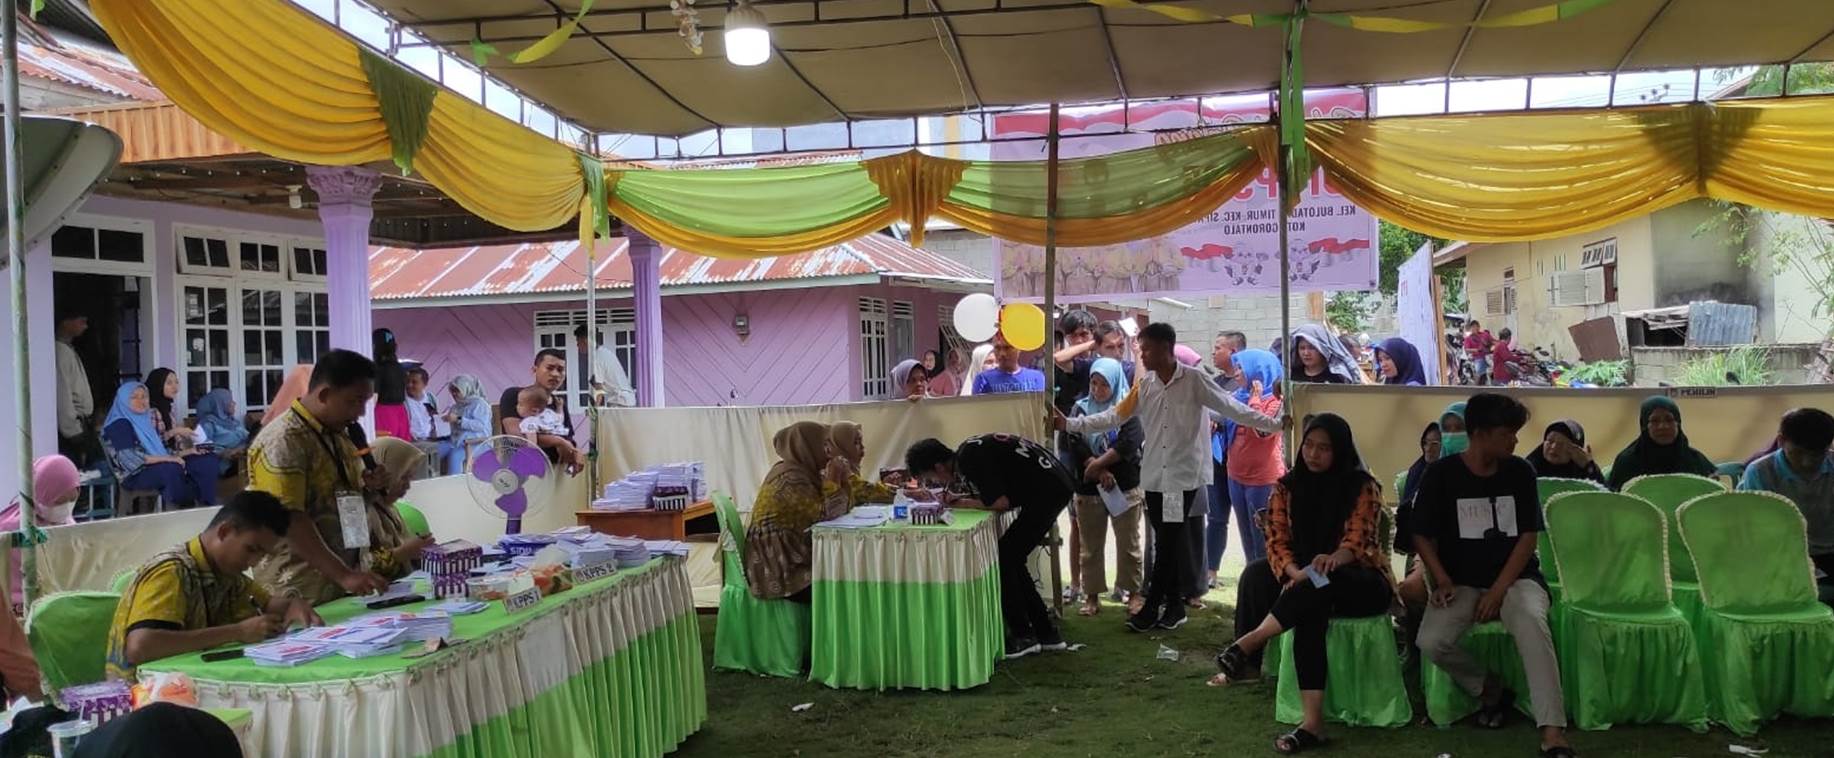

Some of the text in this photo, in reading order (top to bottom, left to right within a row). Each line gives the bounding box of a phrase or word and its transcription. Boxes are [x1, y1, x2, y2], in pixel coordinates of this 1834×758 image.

[583, 562, 614, 580] KPPS 2
[513, 591, 535, 608] KPPS
